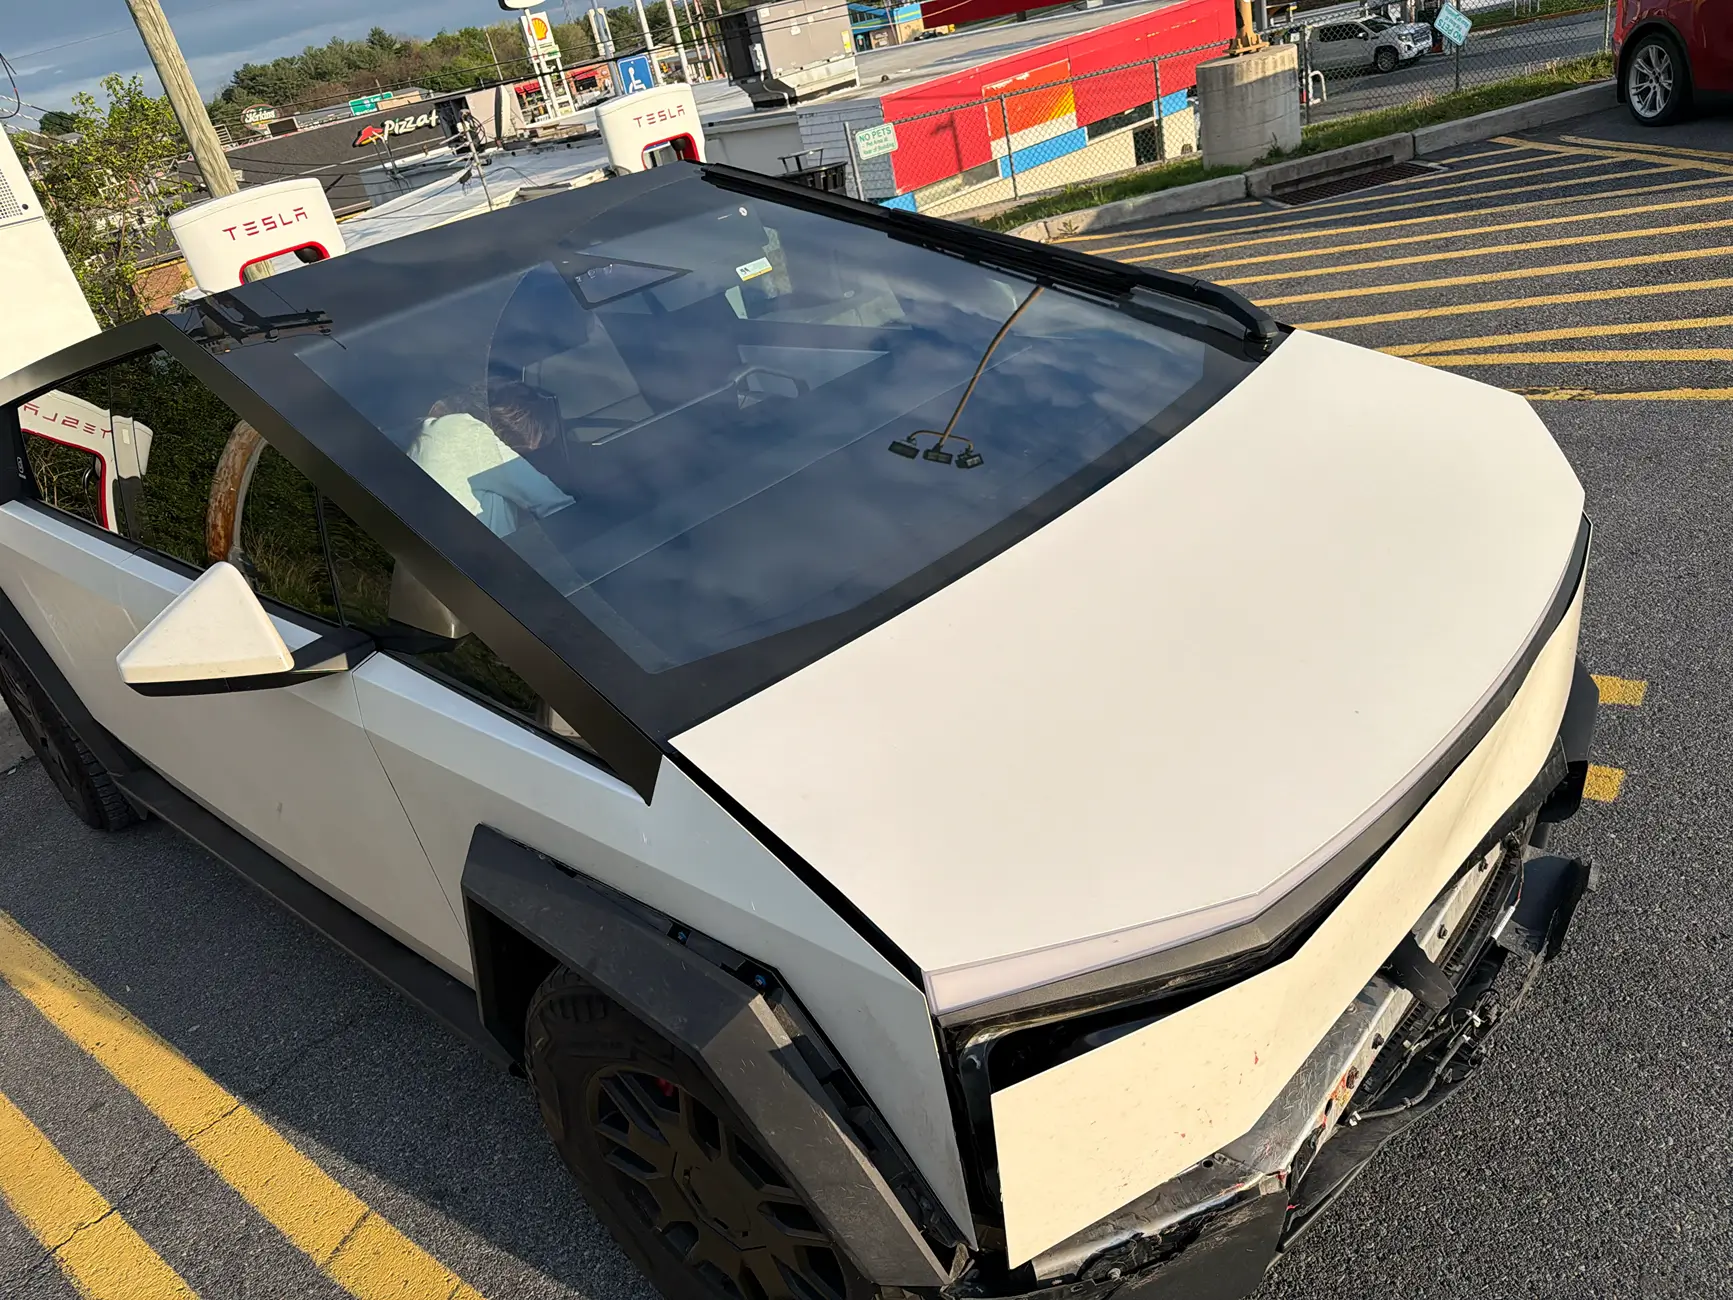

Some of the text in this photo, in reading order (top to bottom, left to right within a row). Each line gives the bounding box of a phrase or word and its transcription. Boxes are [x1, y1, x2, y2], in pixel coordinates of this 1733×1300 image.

[1437, 18, 1463, 41] NO PETS
[383, 114, 428, 141] Pizza
[633, 105, 686, 128] TESLA
[859, 126, 892, 142] NO PETS
[221, 206, 308, 240] TESLA
